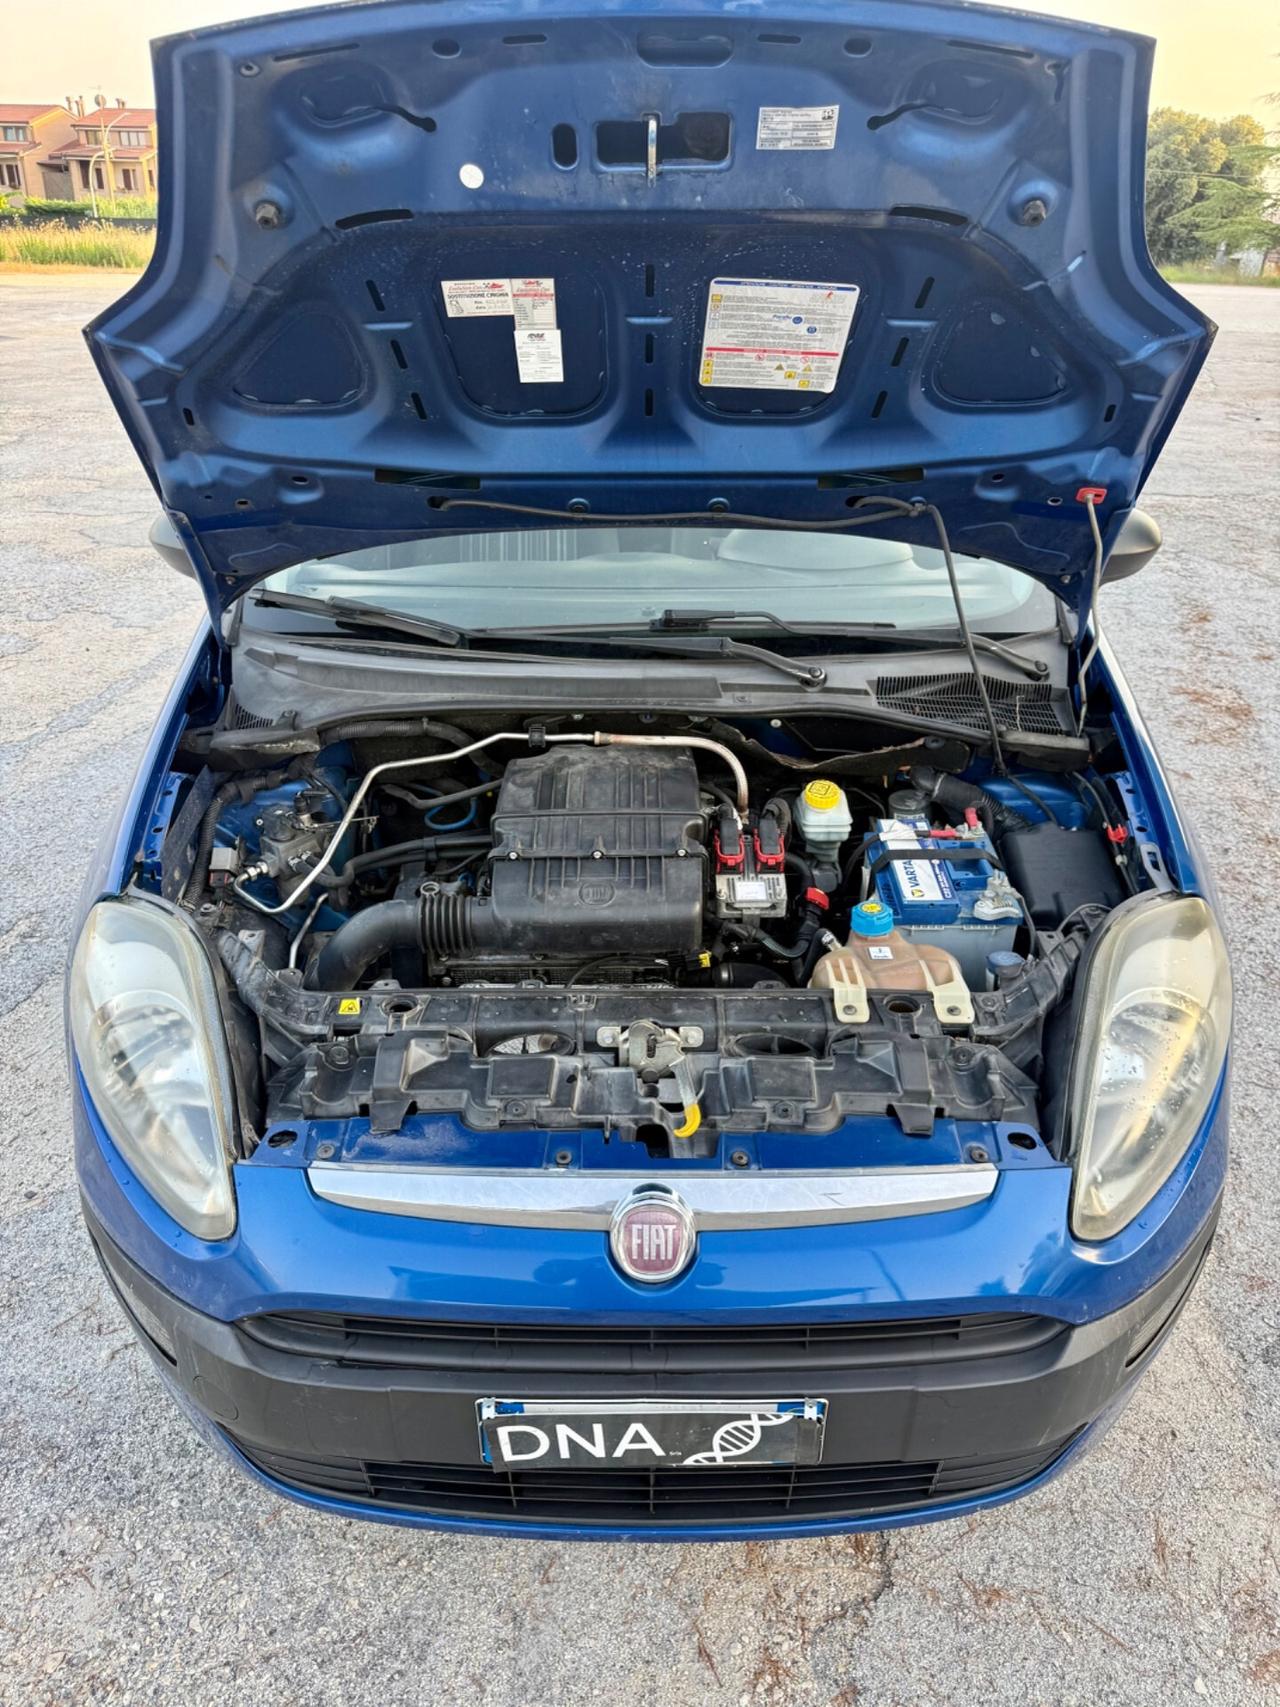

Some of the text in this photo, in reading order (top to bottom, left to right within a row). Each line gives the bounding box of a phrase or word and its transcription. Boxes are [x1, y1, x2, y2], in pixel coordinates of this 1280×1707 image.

[902, 860, 920, 888] VARTA
[631, 1224, 677, 1260] FIAT
[496, 1423, 666, 1462] DNA
